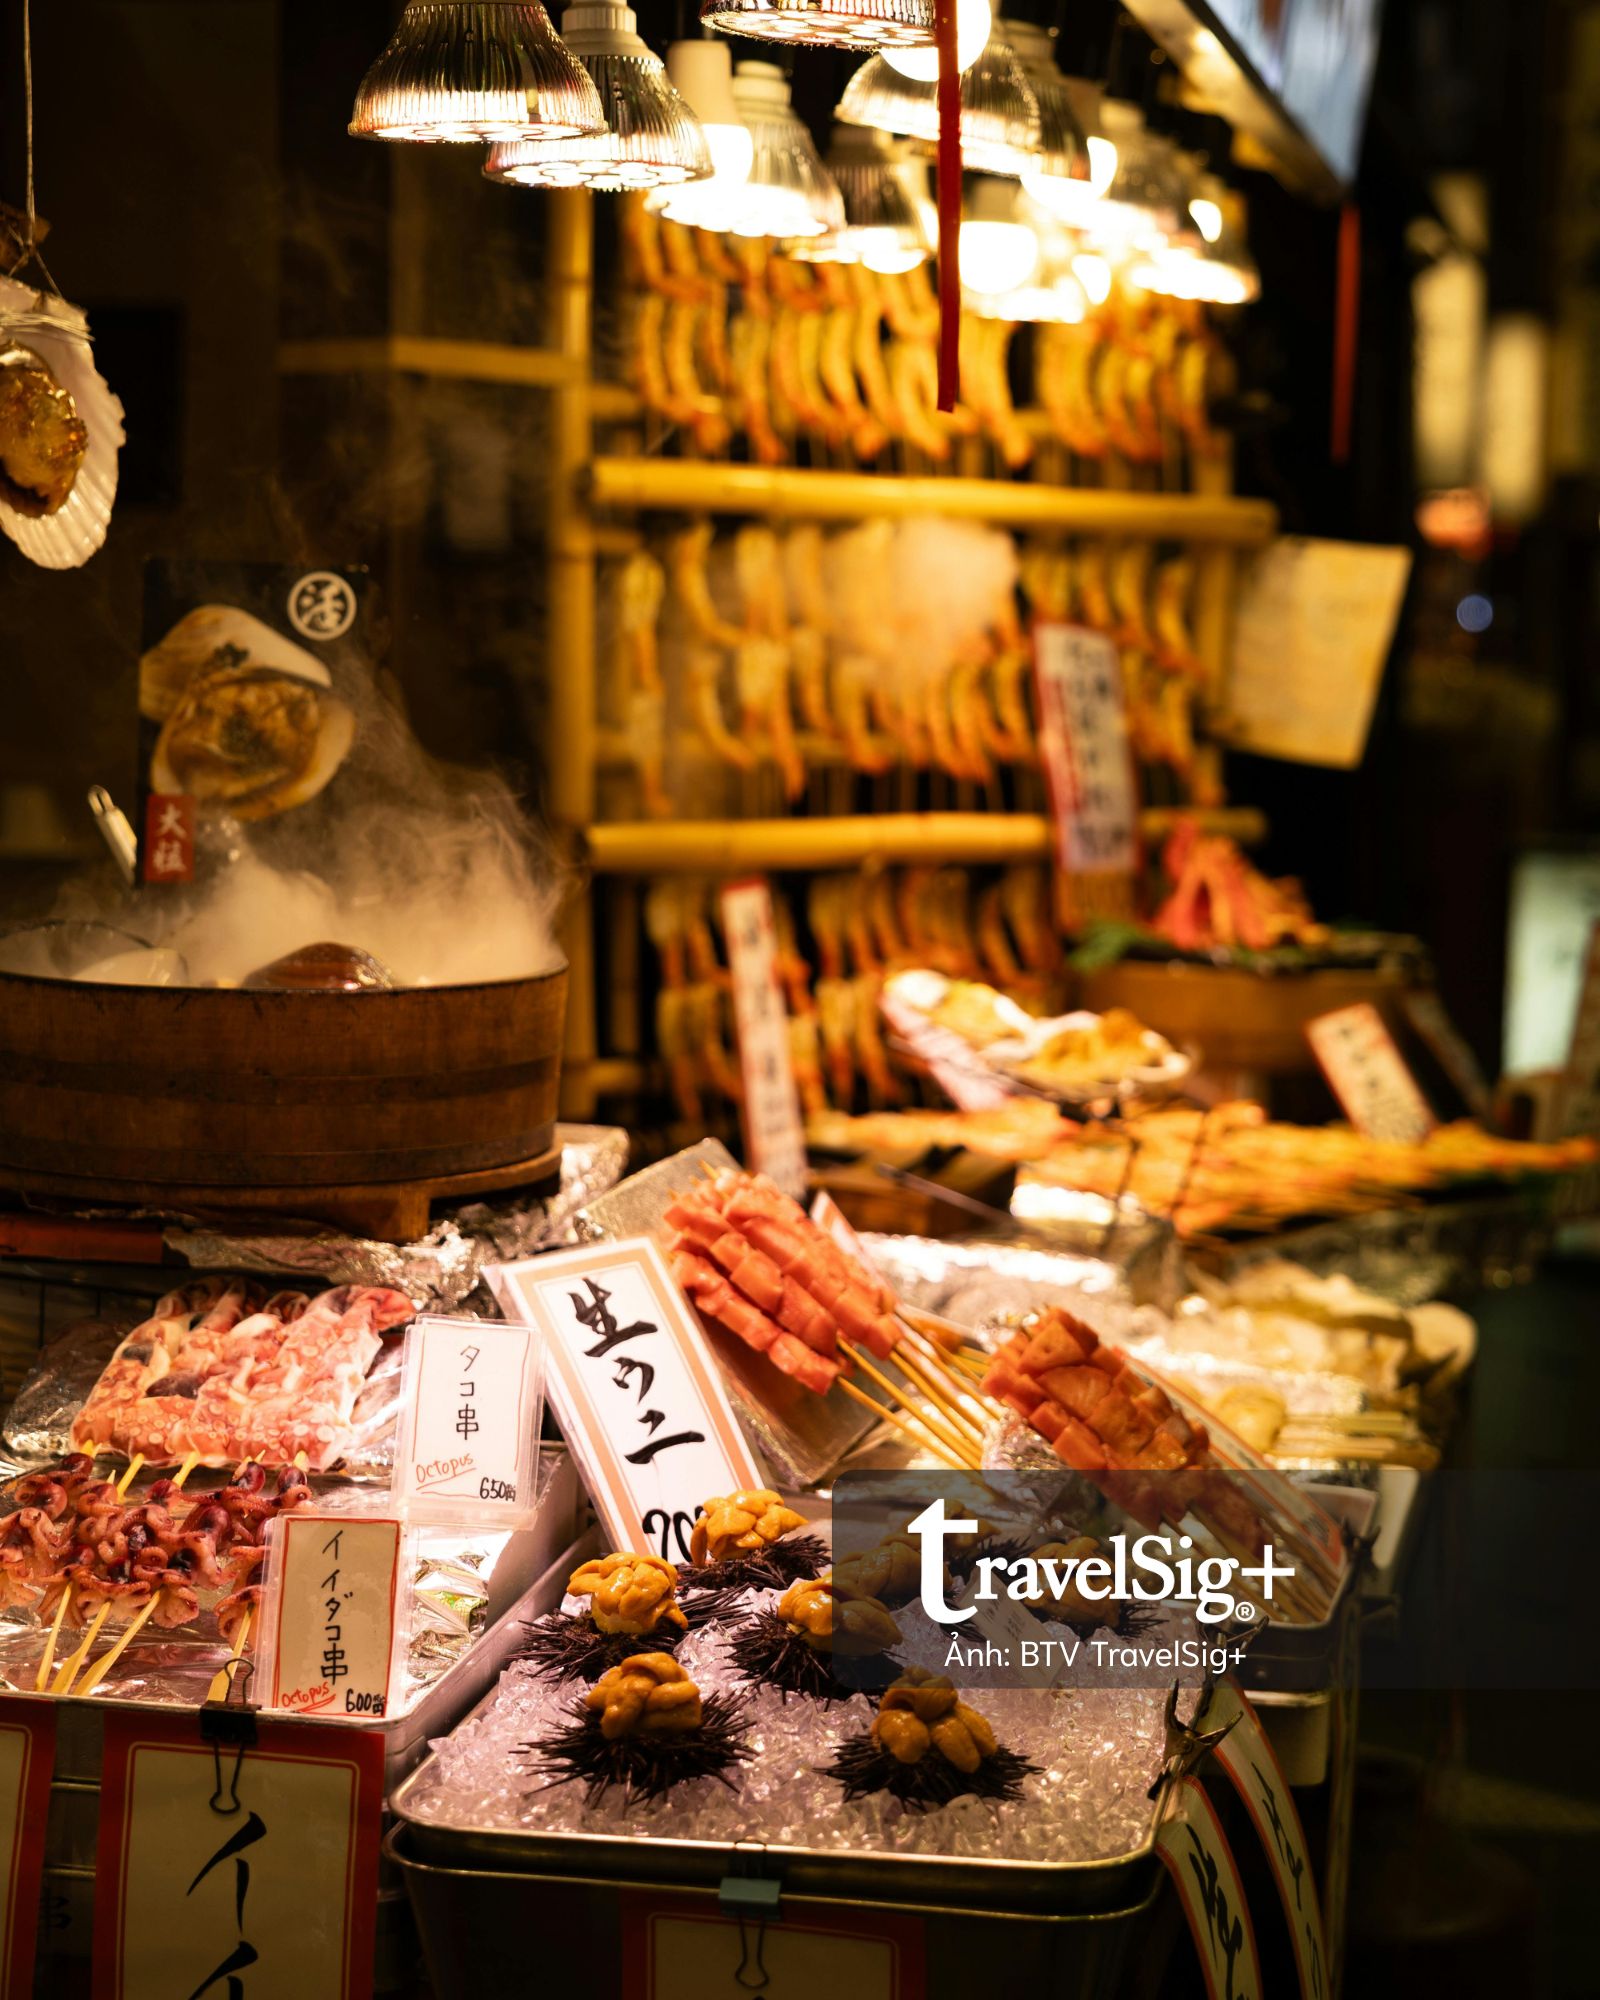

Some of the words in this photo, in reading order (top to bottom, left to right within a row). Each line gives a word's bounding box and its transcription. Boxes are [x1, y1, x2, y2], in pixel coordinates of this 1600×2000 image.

[456, 1345, 480, 1441] タコ串
[416, 1453, 474, 1484] Octopus
[320, 1530, 354, 1685] イイダコ串
[281, 1681, 330, 1708] Octopus
